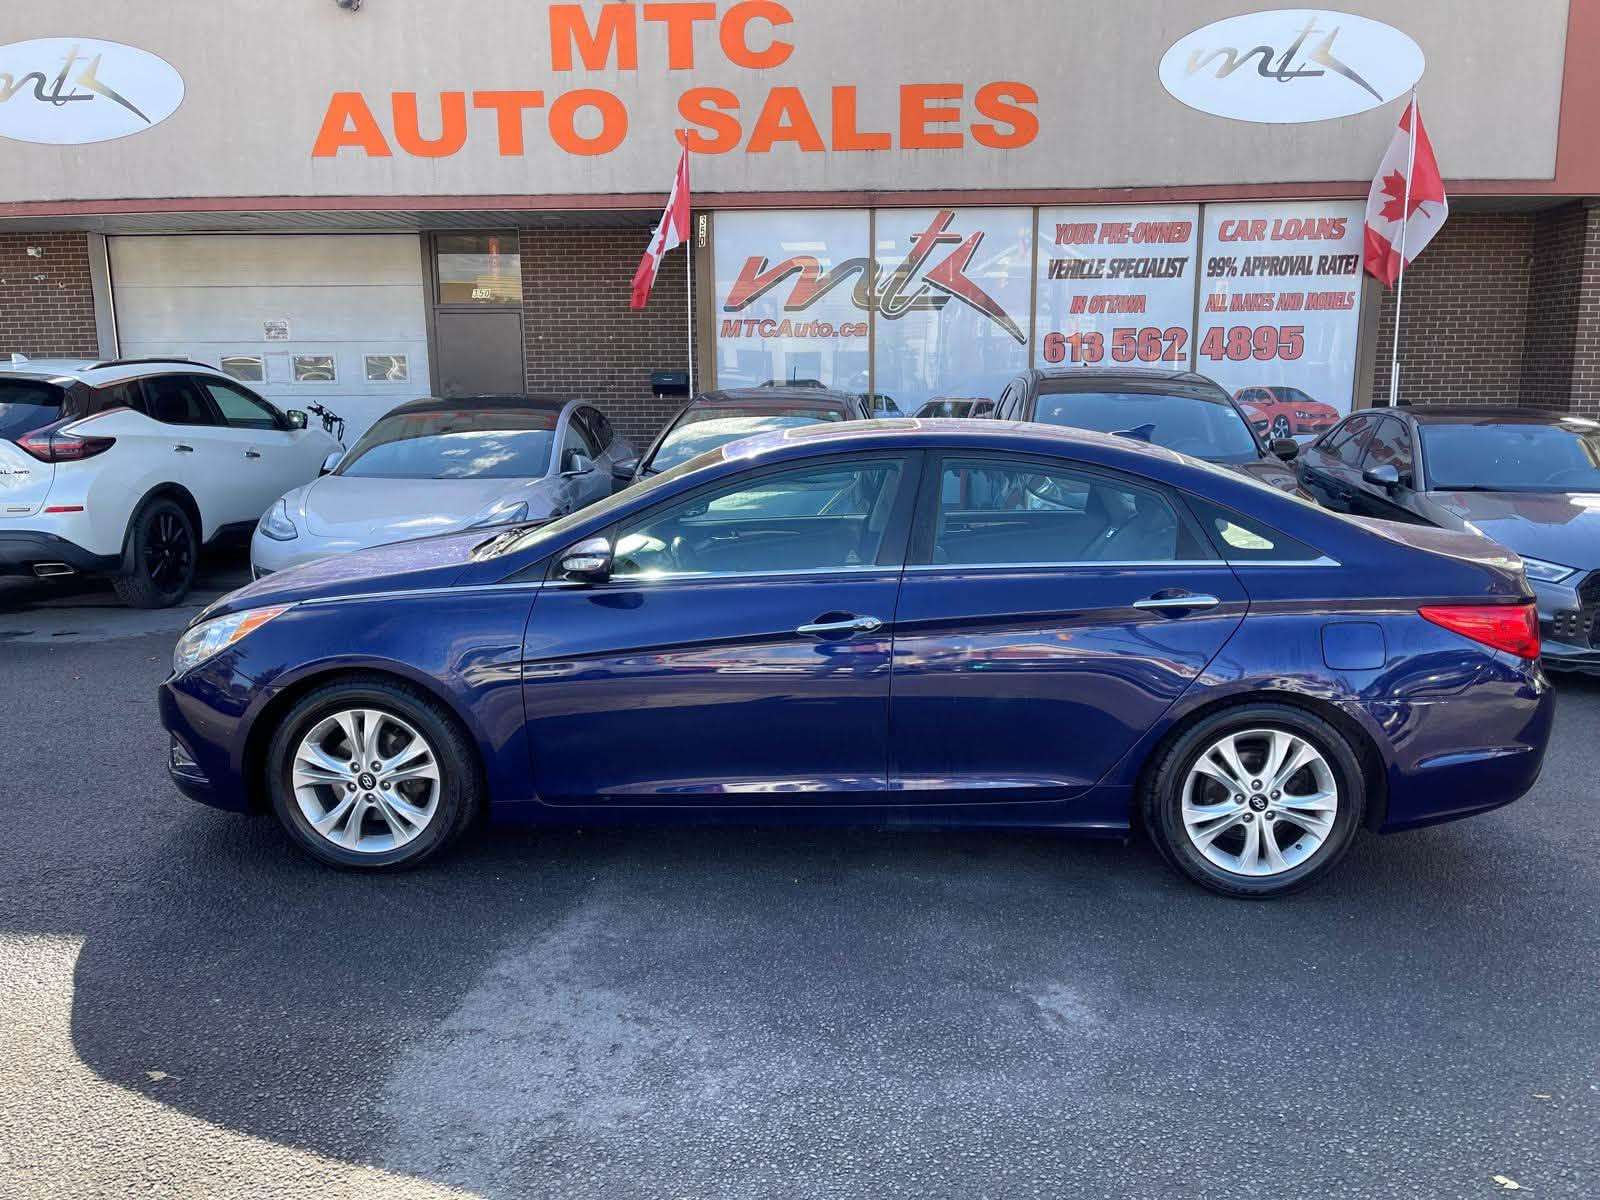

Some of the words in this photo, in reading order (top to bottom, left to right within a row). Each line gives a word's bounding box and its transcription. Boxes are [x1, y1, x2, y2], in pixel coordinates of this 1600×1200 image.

[549, 0, 794, 71] MTC
[311, 88, 628, 157] AUTO
[674, 81, 1040, 154] SALES
[1055, 223, 1097, 244] YOUR
[1098, 221, 1192, 244] PRE-OWNED
[1218, 219, 1267, 242] CAR
[1271, 217, 1347, 240] LOANS
[1048, 258, 1106, 279] VEHICLE
[1106, 256, 1188, 279] SPECIALIST
[1207, 256, 1237, 277] 99%
[1240, 255, 1313, 276] APPROVAL
[1316, 254, 1359, 275] RATE!
[1070, 295, 1088, 314] IN
[1088, 294, 1147, 314] OTTAWA
[1205, 293, 1228, 312] ALL
[1229, 292, 1275, 312] MAKES
[1275, 292, 1304, 312] AND
[1304, 291, 1355, 311] MODELS
[720, 318, 868, 338] MTCAuto.ca
[1043, 331, 1105, 363] 613
[1112, 326, 1188, 362] 562
[1200, 325, 1304, 361] 4895
